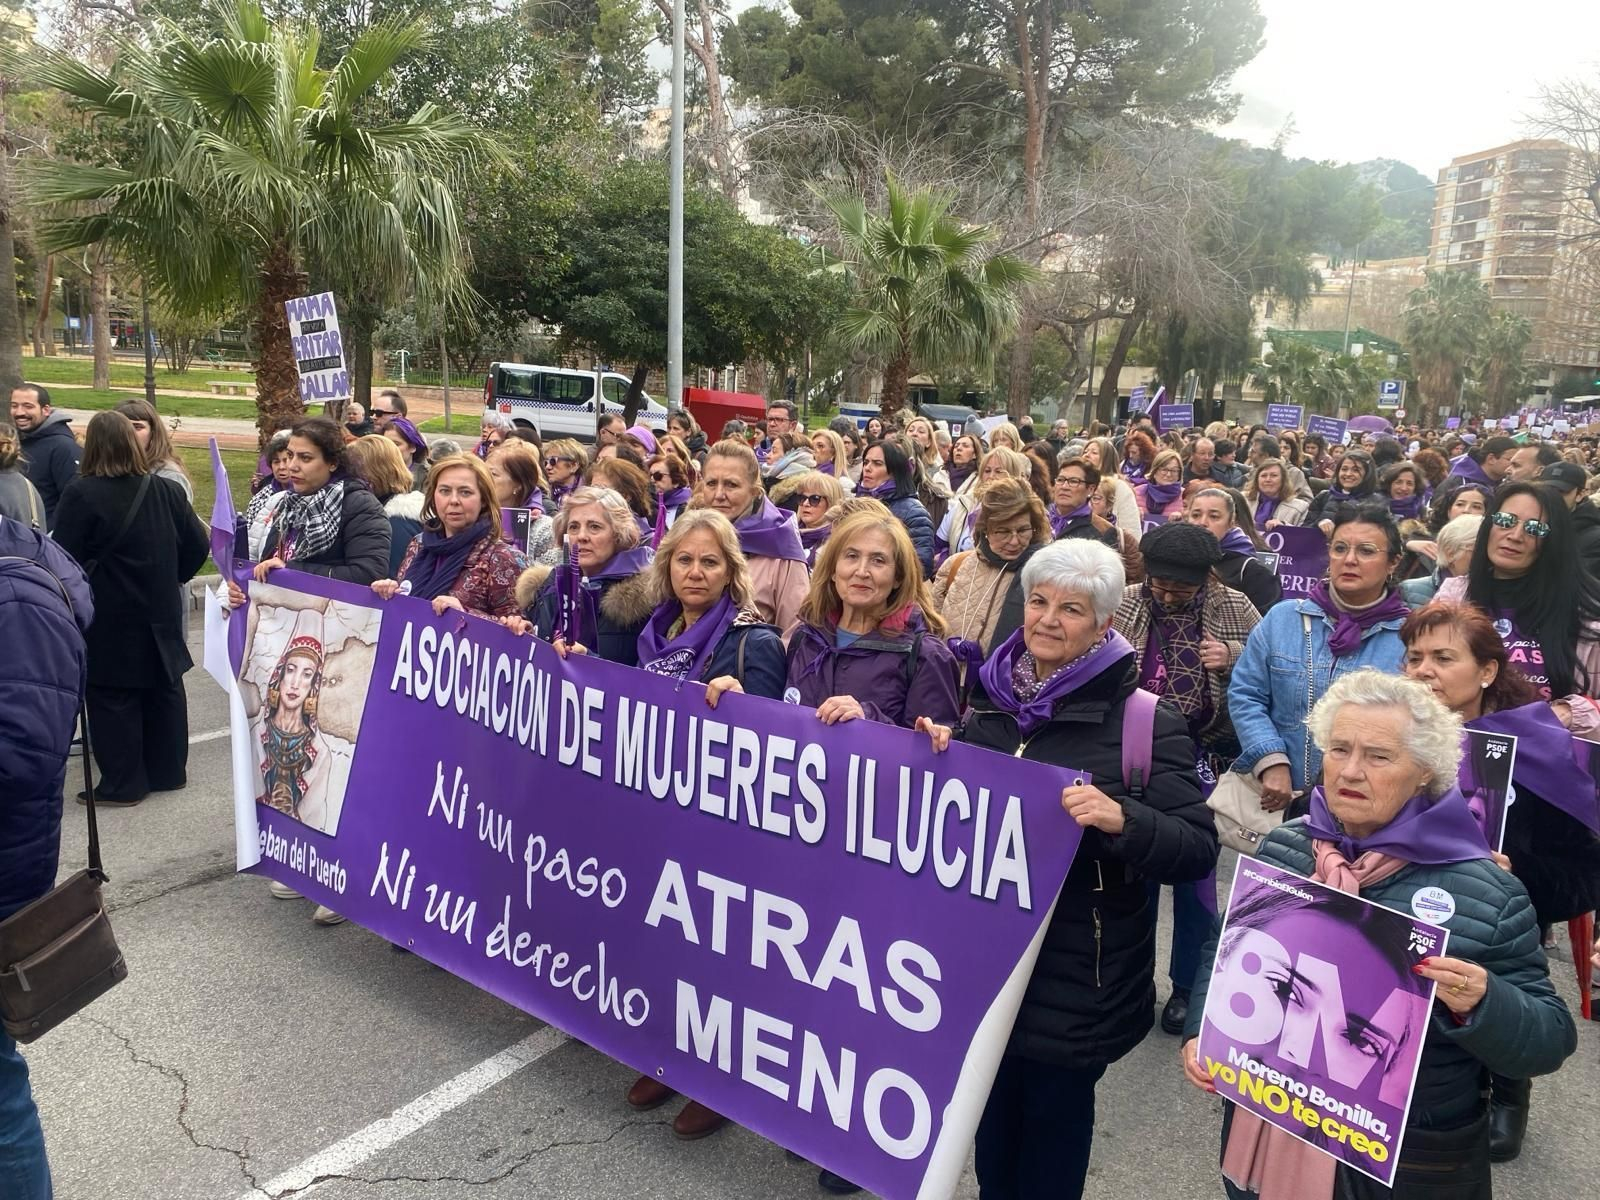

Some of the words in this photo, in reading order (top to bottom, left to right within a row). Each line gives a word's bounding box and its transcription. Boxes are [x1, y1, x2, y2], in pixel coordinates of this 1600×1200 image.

[286, 294, 333, 322] MAMA
[300, 371, 350, 400] CALLAR
[1384, 382, 1396, 393] P
[389, 621, 551, 756] ASOCIACIÓN
[559, 679, 604, 777] DE
[614, 696, 827, 844] MUJERES
[845, 754, 1031, 910] ILUCIA
[1486, 743, 1508, 753] PSOE
[259, 823, 287, 864] eban
[289, 837, 307, 874] del
[309, 845, 347, 895] Puerto
[1243, 869, 1314, 902] #CambiaElGuion
[427, 761, 469, 829] Ni
[477, 802, 514, 863] un
[524, 833, 626, 909] paso
[644, 858, 942, 1032] ATRAS
[1409, 931, 1436, 949] PSOE
[370, 841, 416, 910] Ni
[424, 884, 477, 944] un
[486, 895, 650, 1027] derecho
[676, 978, 950, 1160] MENO
[1206, 926, 1430, 1110] 8M
[1228, 1046, 1309, 1098] Moreno
[1308, 1085, 1391, 1142] Bonilla,
[1238, 1069, 1290, 1114] NO
[1292, 1097, 1320, 1128] te
[1321, 1117, 1389, 1163] creo
